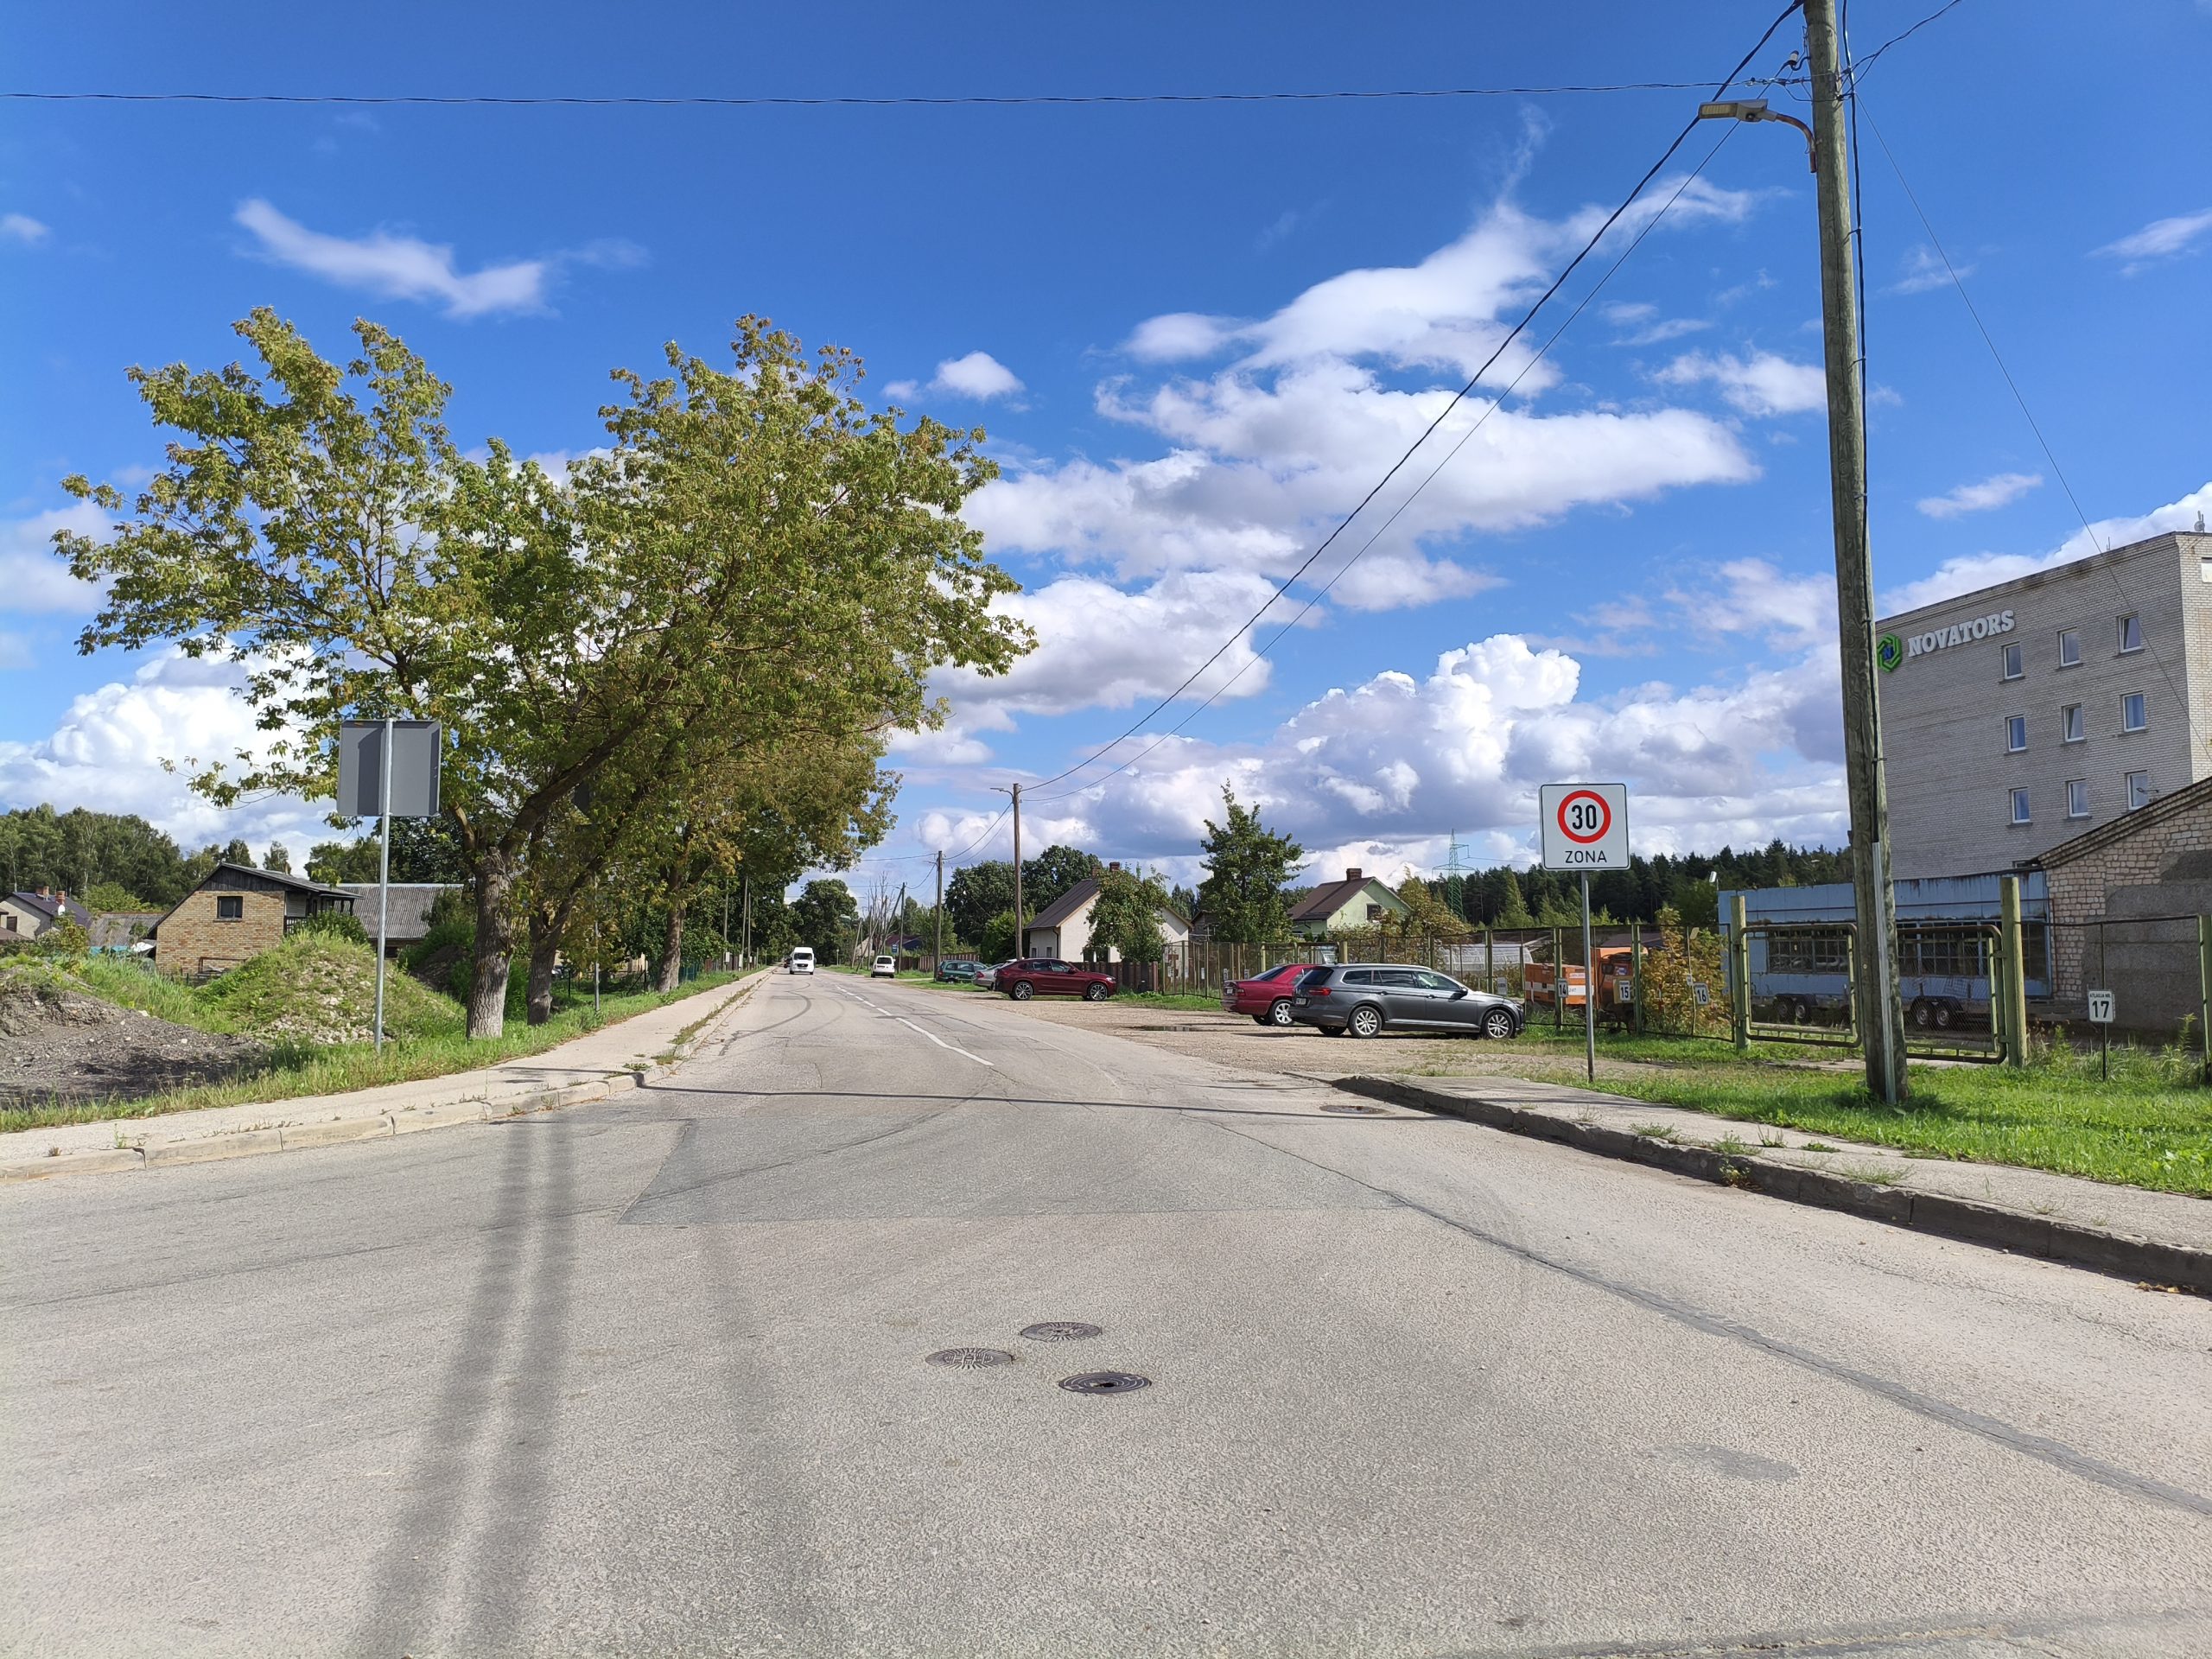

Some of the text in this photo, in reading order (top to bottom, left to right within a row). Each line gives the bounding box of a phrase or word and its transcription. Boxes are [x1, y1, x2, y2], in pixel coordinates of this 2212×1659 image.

[1908, 610, 2015, 657] NOVATORS
[1572, 804, 1598, 830] 30
[1565, 850, 1607, 863] ZONA
[1559, 983, 1567, 995] 14
[1620, 987, 1629, 999] 15
[1697, 989, 1707, 1002] 16
[2092, 1001, 2109, 1018] 17
